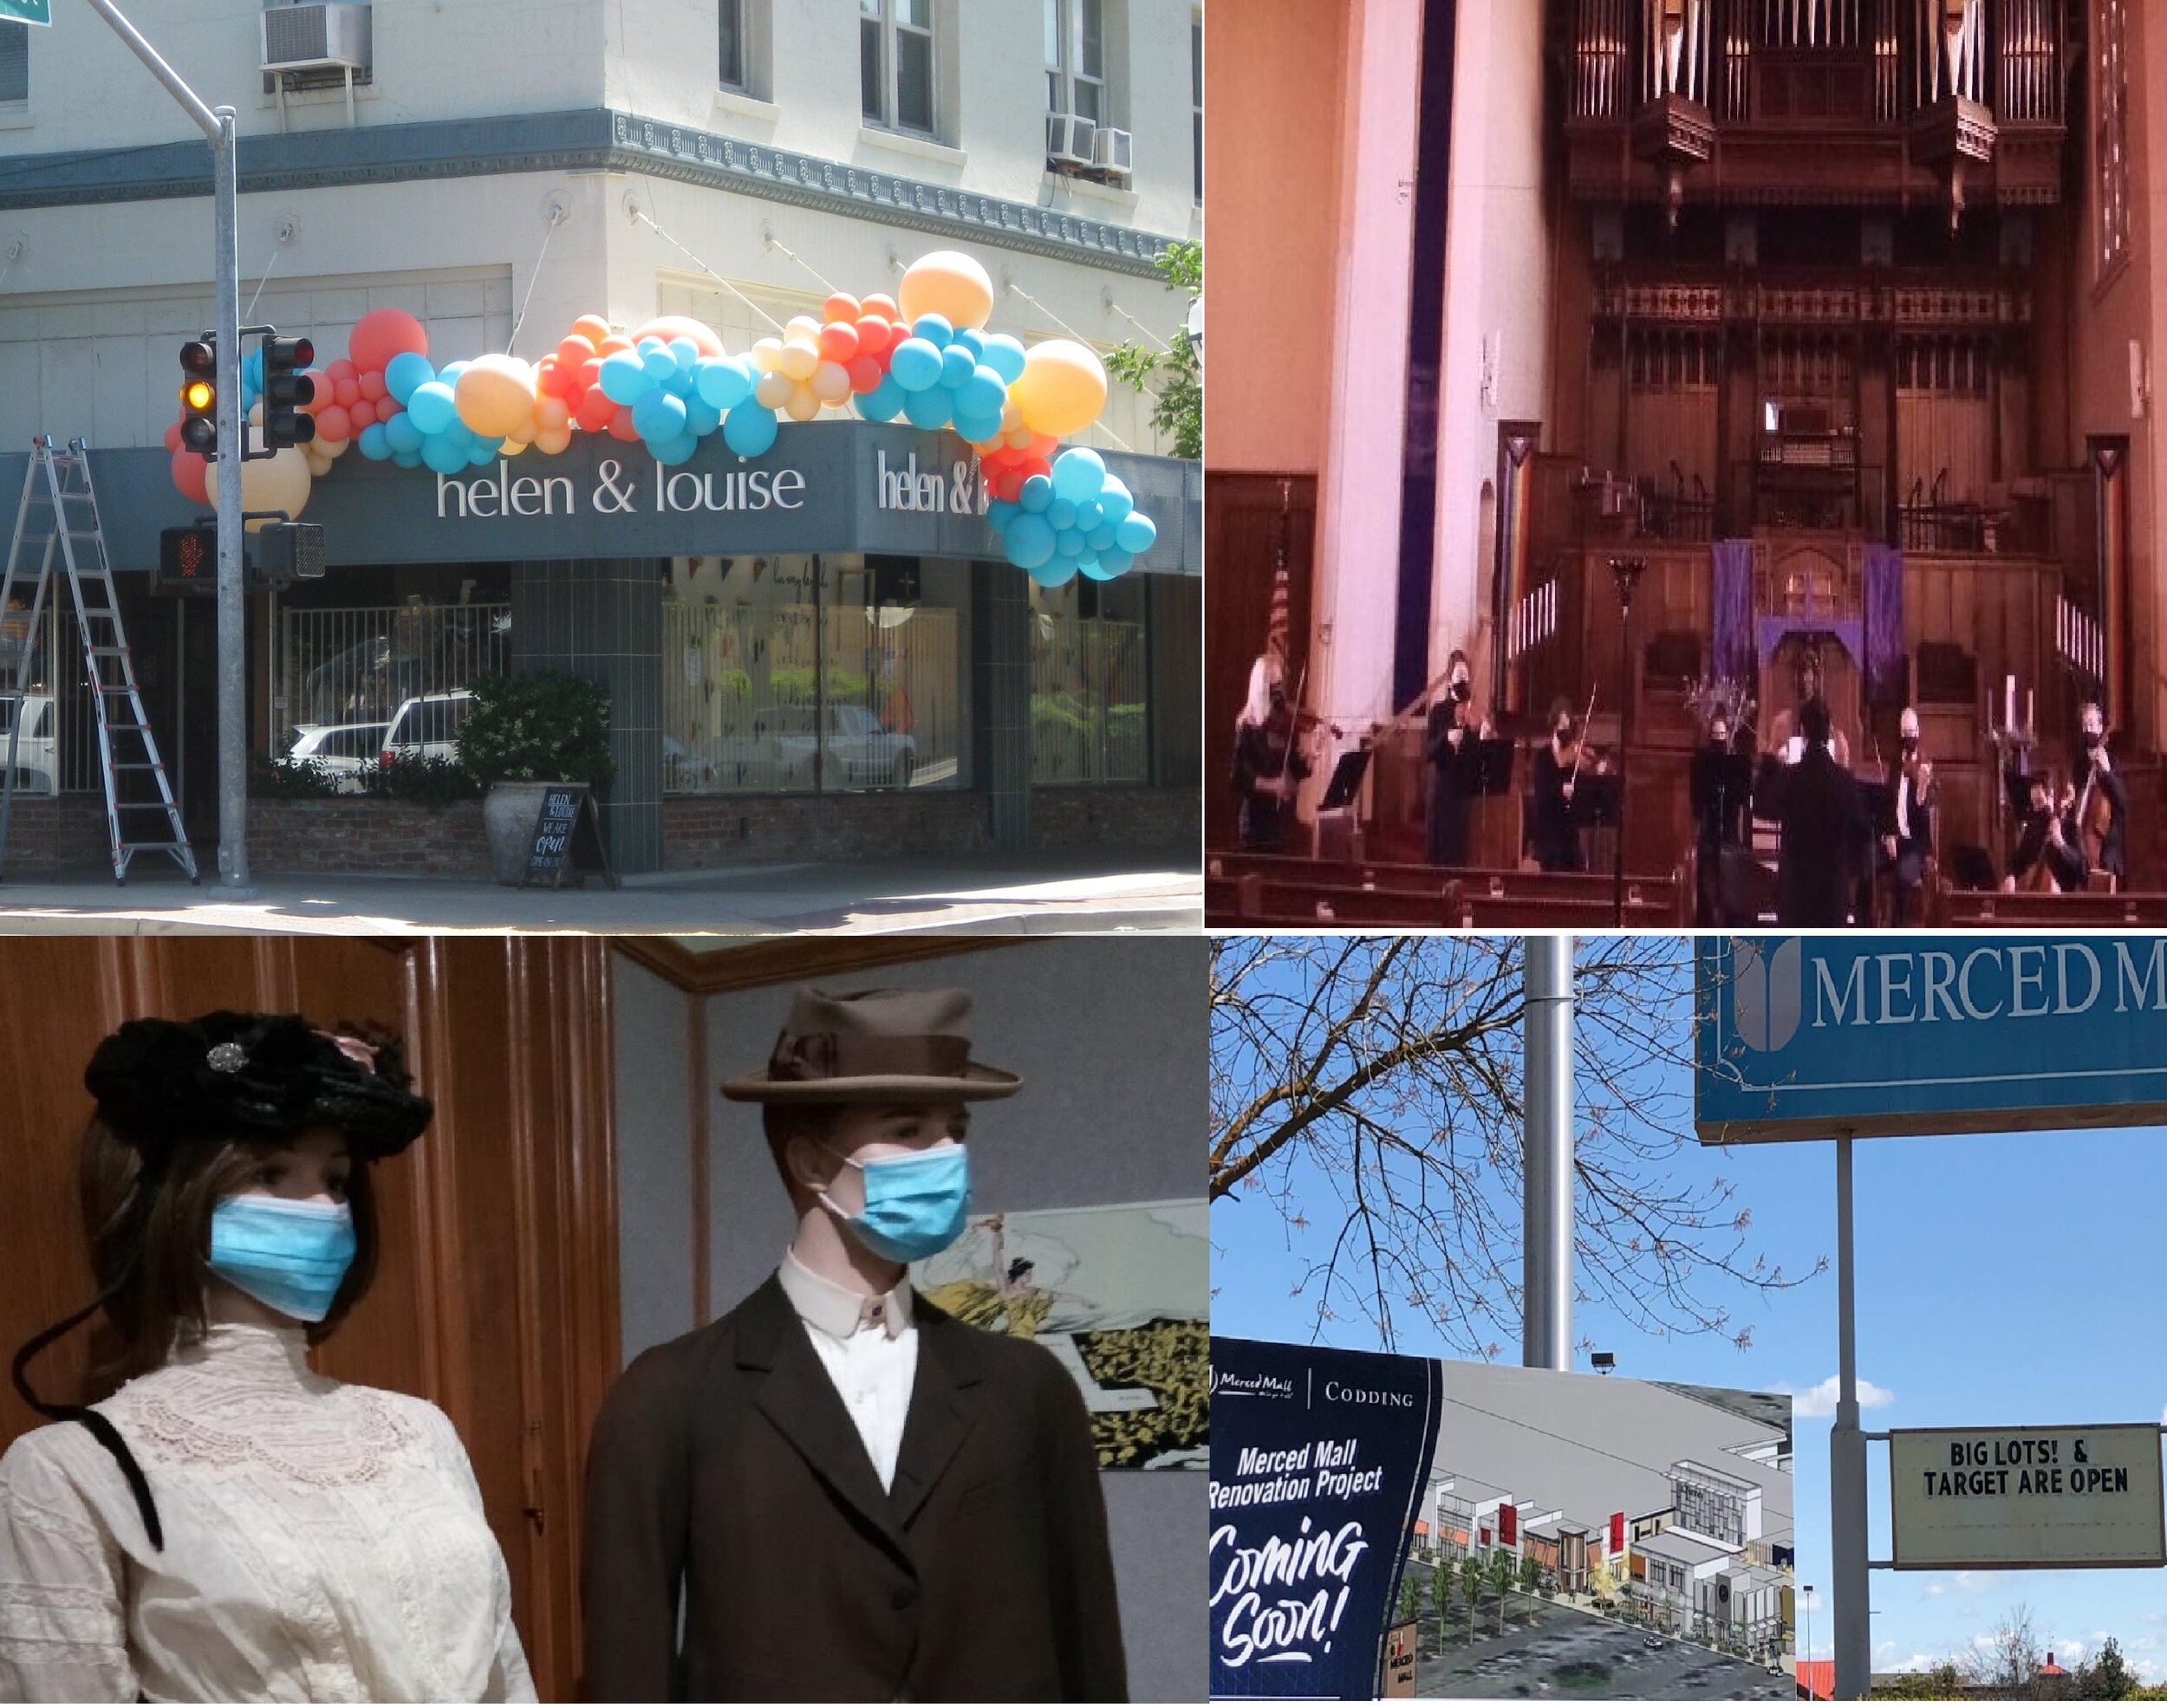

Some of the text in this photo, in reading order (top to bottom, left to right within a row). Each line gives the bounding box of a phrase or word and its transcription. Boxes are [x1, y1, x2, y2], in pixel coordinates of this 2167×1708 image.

[437, 455, 806, 517] helen & louise
[877, 450, 945, 512] helen
[950, 461, 973, 514] &
[548, 794, 571, 805] HELEN
[1812, 942, 2102, 1027] MERCED
[1325, 1380, 1414, 1407] CODDING
[1237, 1438, 1357, 1476] Merced Mall
[1950, 1438, 2088, 1466] BIG LOTS! &
[1209, 1465, 1383, 1510] Renovation Project
[1923, 1468, 2128, 1496] TARGET ARE OPEN
